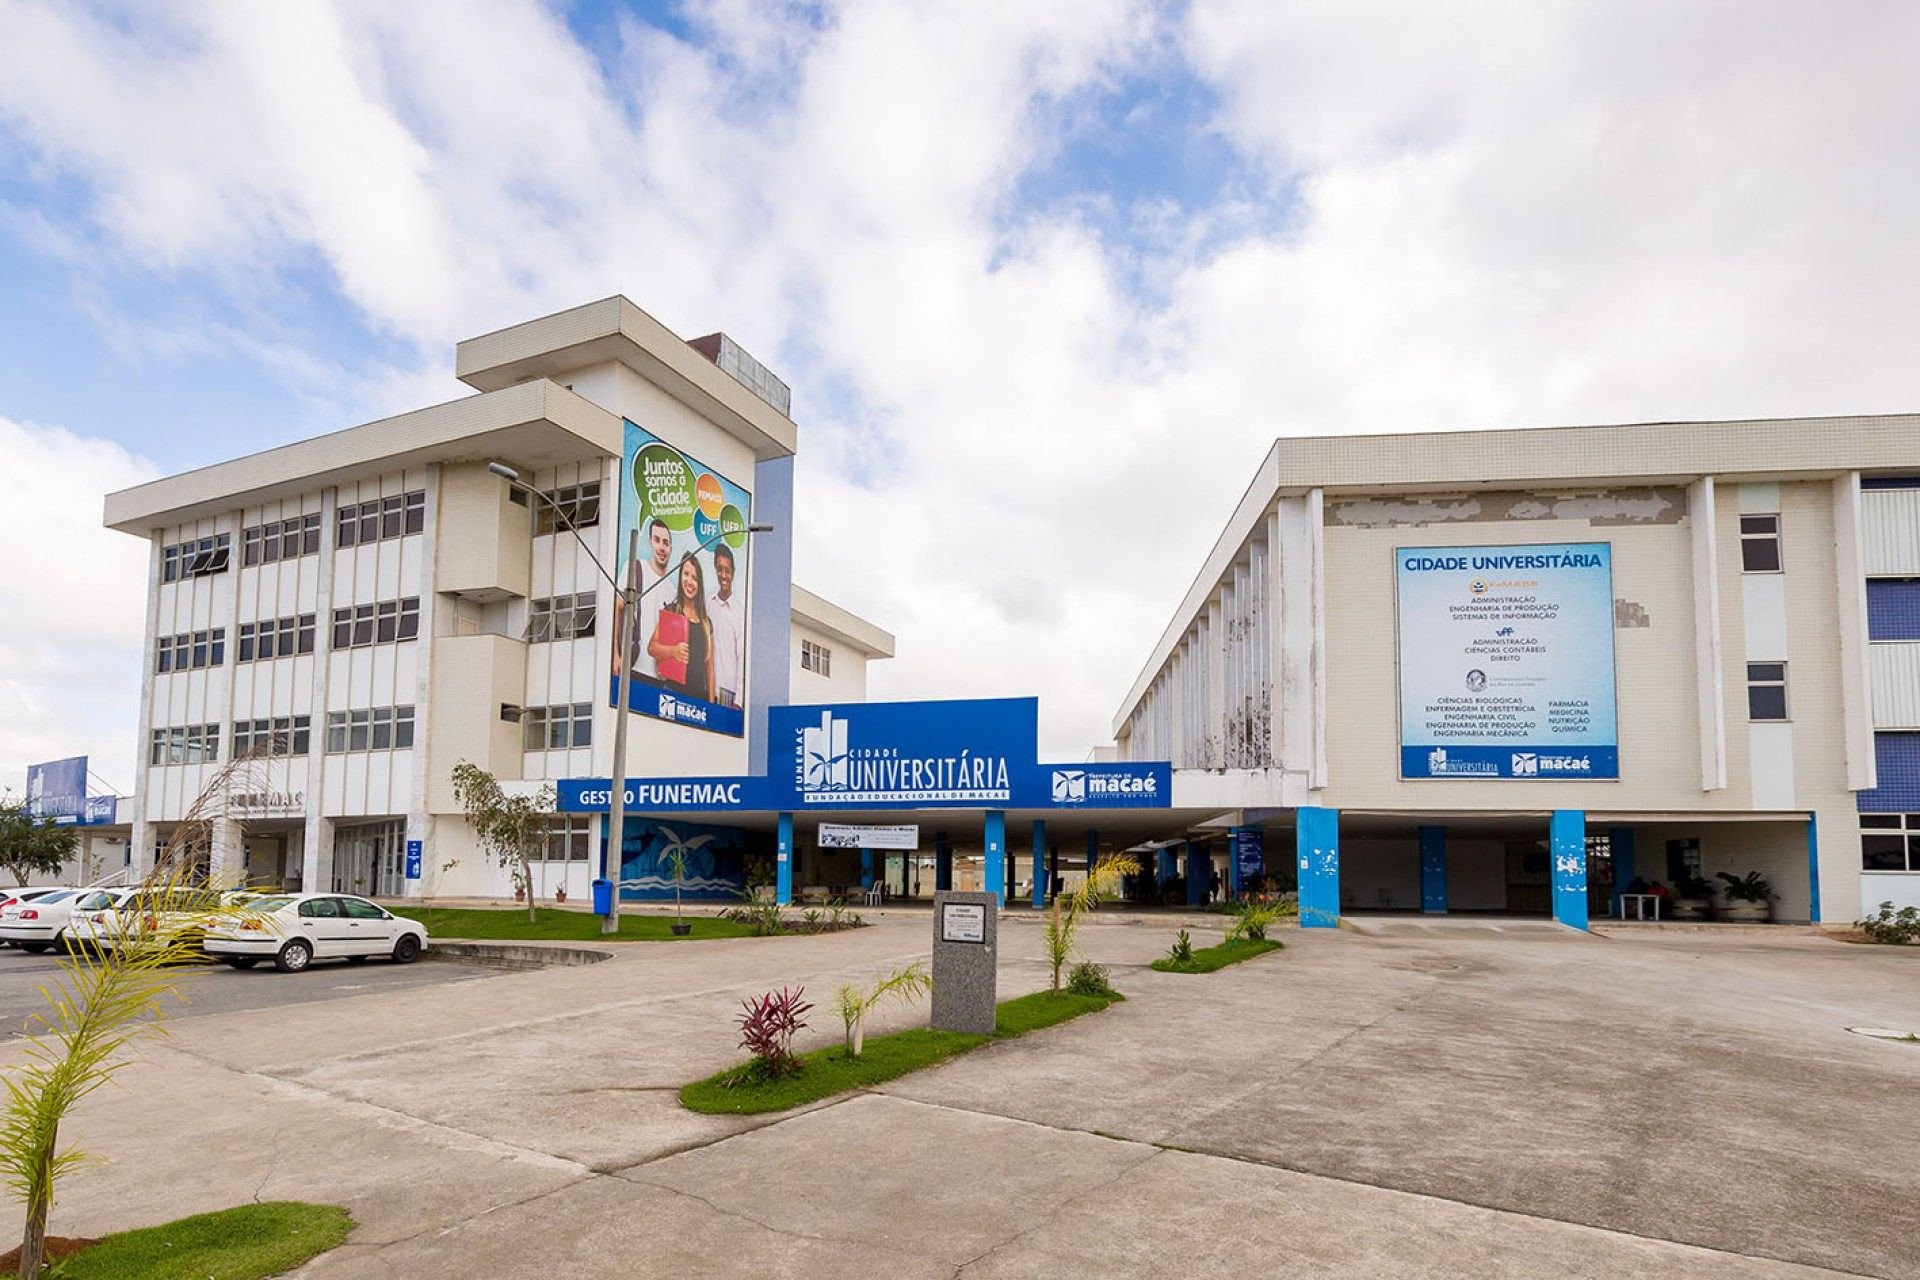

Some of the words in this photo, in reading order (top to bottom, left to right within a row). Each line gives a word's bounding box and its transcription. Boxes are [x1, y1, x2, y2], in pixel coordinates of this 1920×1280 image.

[643, 457, 684, 475] Juntos
[645, 475, 676, 487] somos
[679, 477, 686, 486] a
[648, 487, 690, 505] Cidade
[700, 523, 717, 535] UFF
[1405, 558, 1467, 571] CIDADE
[1472, 551, 1602, 570] UNIVERSITÁRIA
[1471, 596, 1537, 604] ADMINISTRAÇÃO
[1514, 603, 1559, 612] PRODUÇÃO
[1503, 611, 1557, 620] INFORMAÇÃO
[1472, 637, 1538, 646] ADMINISTRAÇÃO
[795, 728, 803, 792] FUNEMAC
[850, 748, 898, 758] CIDADE
[850, 749, 1010, 790] UNIVERSITÁRIA
[1540, 755, 1590, 770] macaé
[1088, 772, 1157, 792] macaé
[580, 791, 634, 804] GESTO
[639, 784, 741, 804] FUNEMAC
